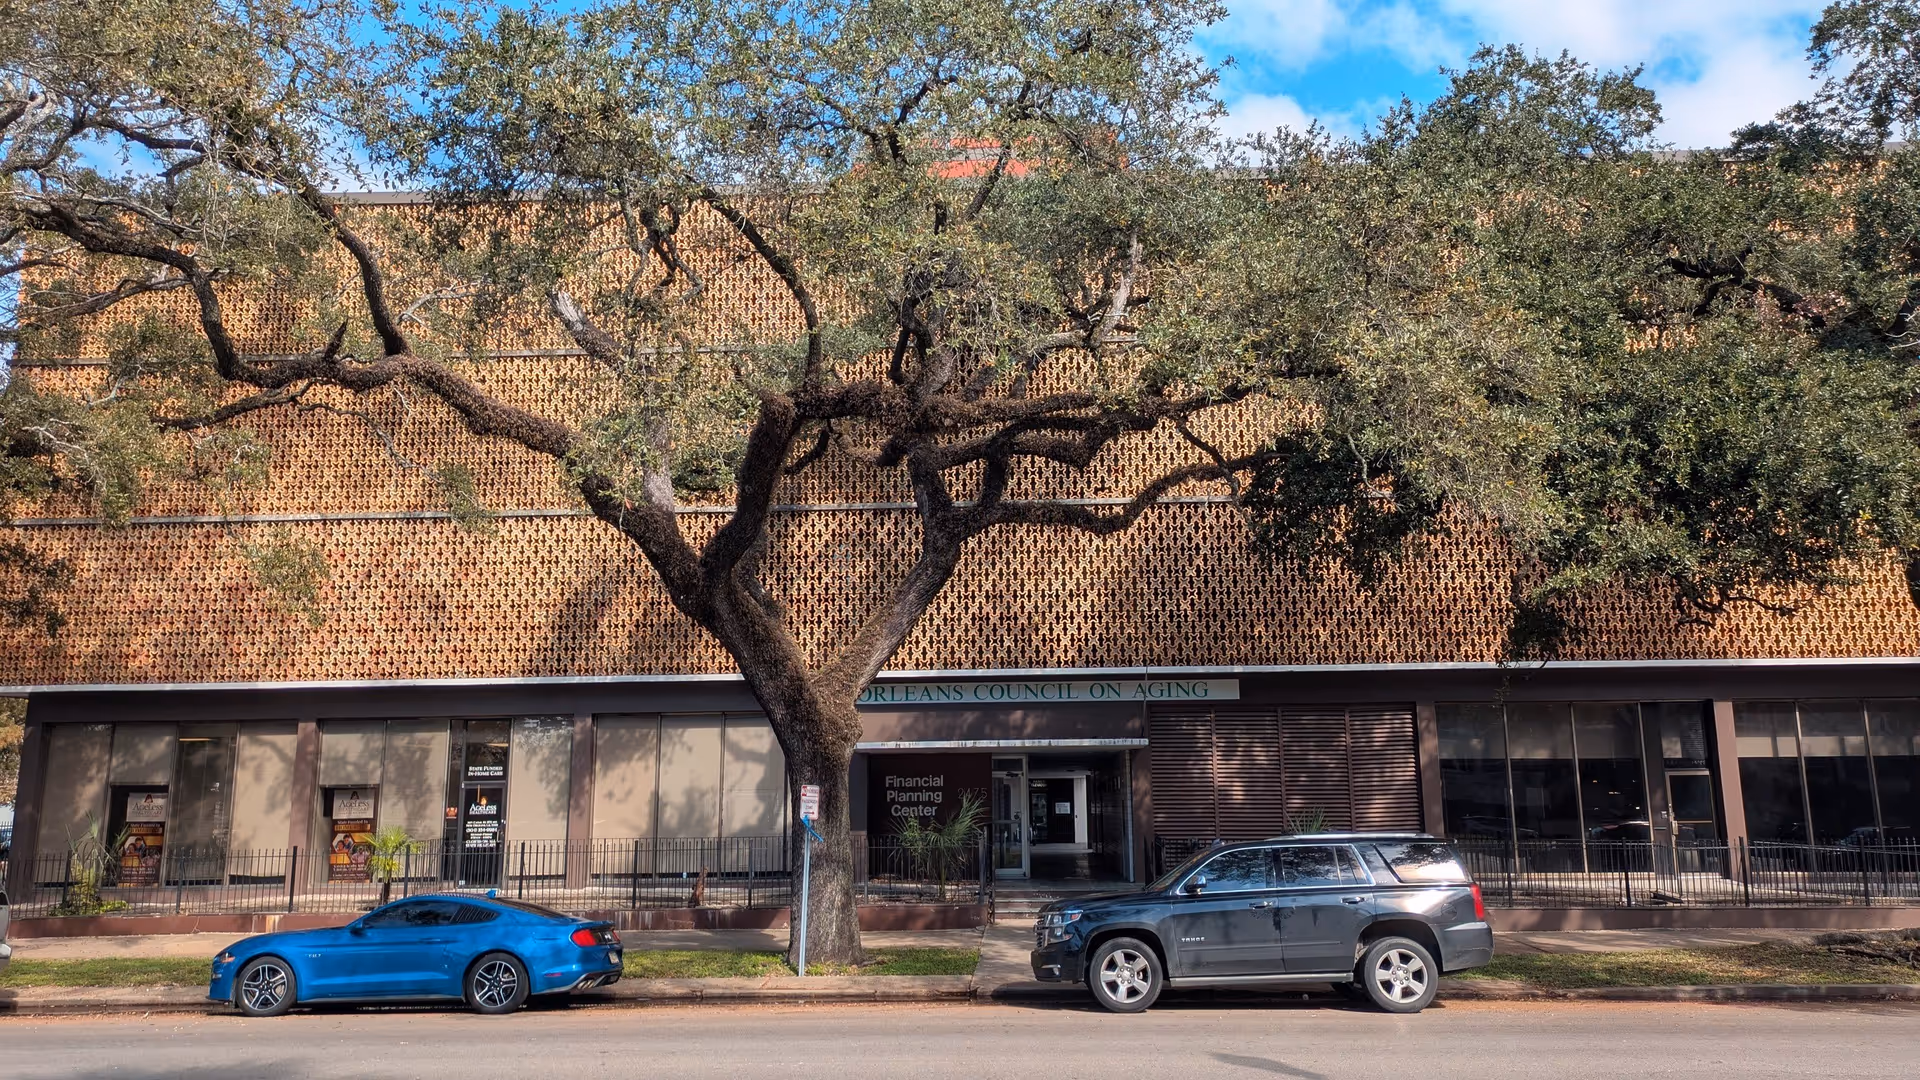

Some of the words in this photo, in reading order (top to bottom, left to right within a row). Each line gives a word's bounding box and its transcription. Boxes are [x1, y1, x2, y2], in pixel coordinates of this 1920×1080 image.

[859, 685, 964, 702] ORLEANS
[974, 683, 1078, 700] COUNCIL
[1089, 682, 1122, 699] ON
[1132, 680, 1208, 698] AGING
[885, 775, 944, 787] Financial
[886, 789, 943, 803] Planning
[891, 804, 938, 817] Center
